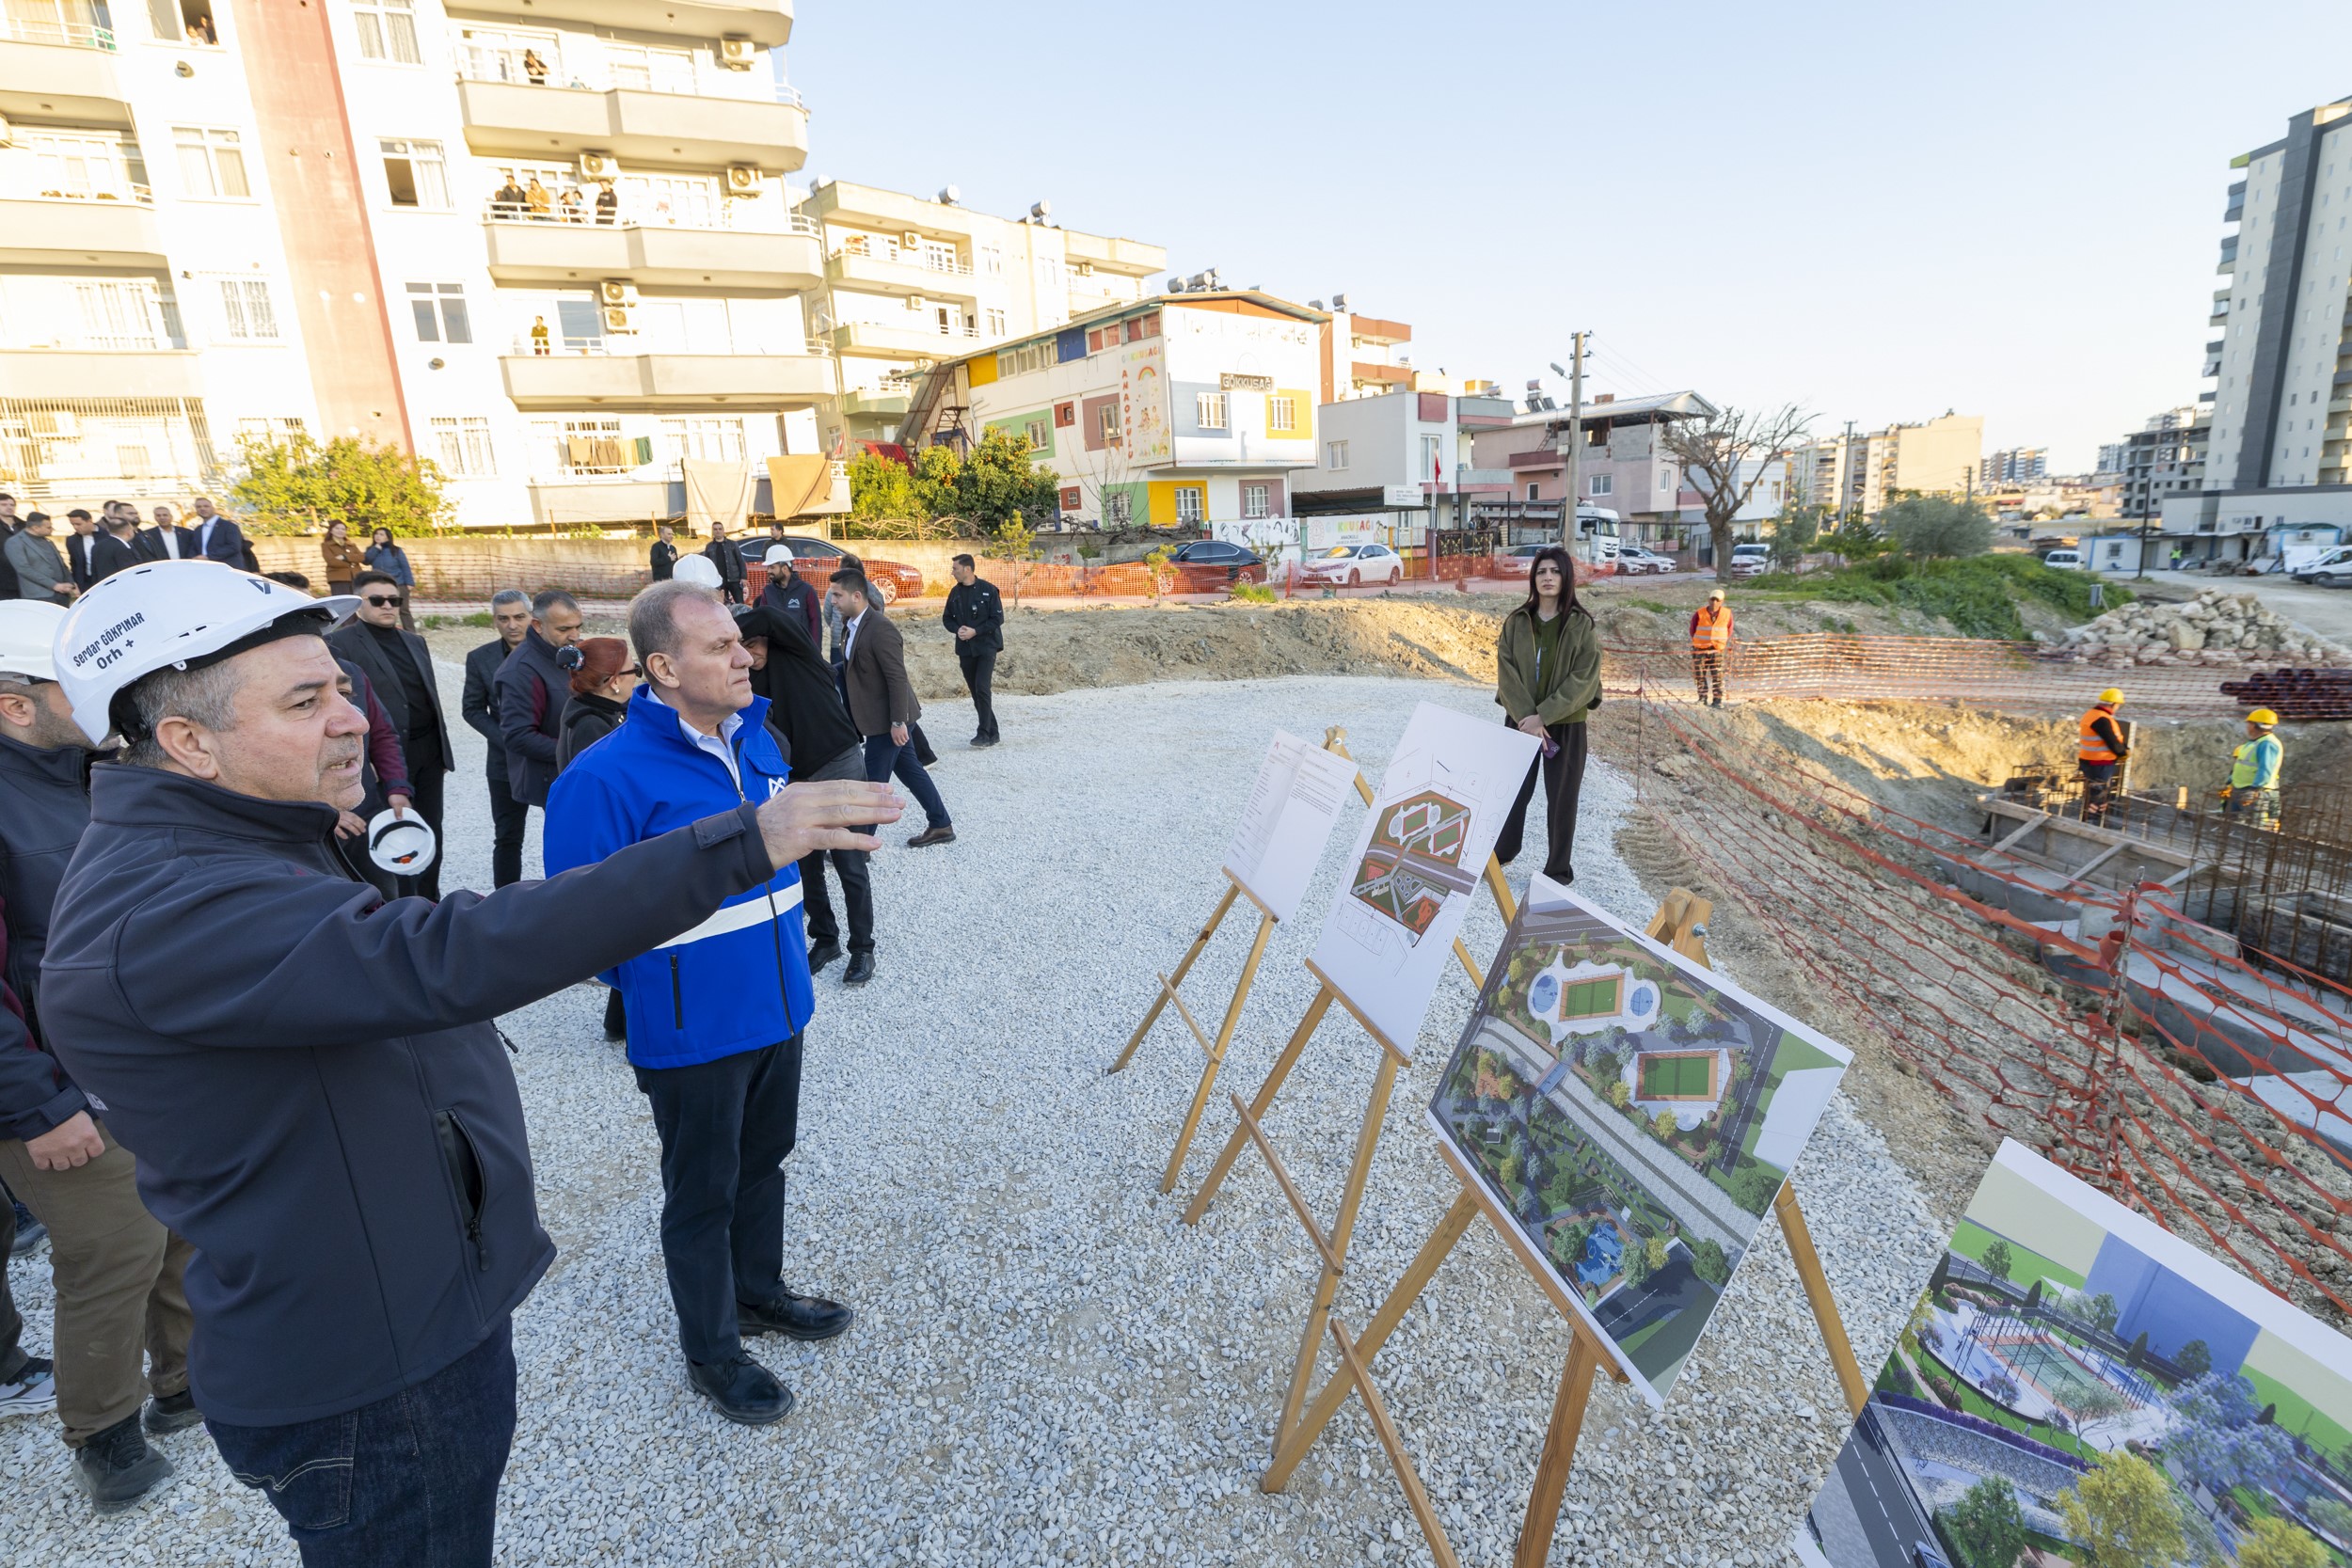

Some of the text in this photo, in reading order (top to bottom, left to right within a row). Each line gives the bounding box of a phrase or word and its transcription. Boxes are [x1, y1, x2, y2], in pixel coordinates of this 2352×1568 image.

[1122, 370, 1134, 459] ANAOKULU
[1326, 517, 1374, 533] GKKUŞAĞI
[73, 612, 145, 667] Serdar GÖKPINAR
